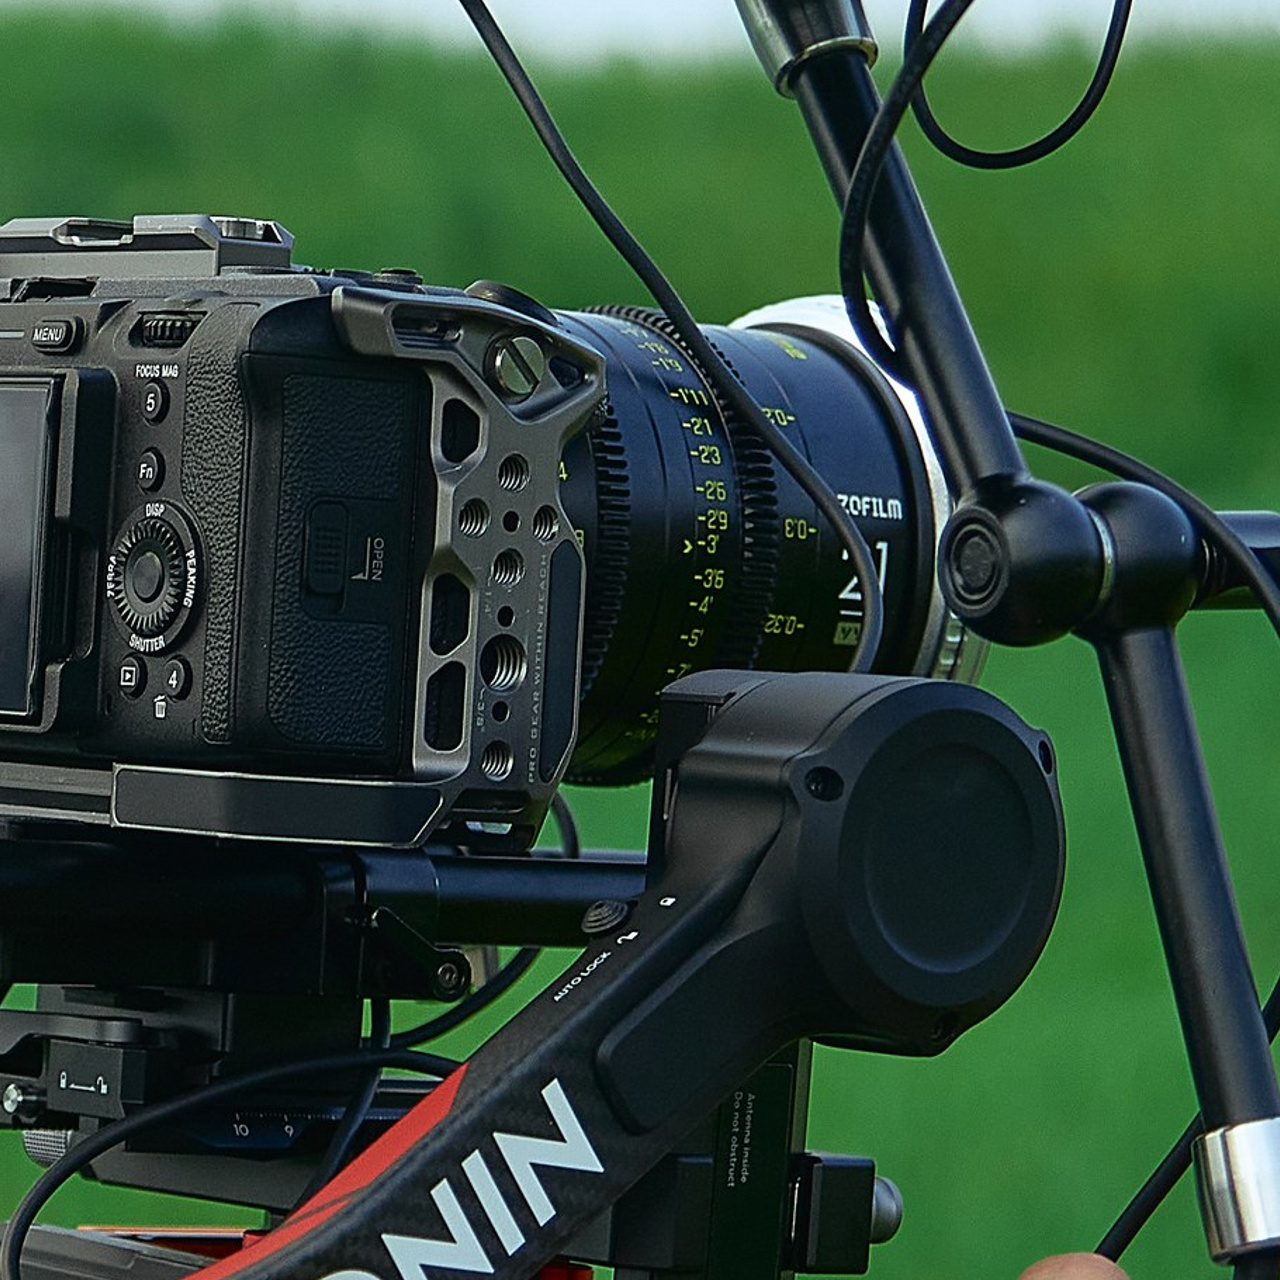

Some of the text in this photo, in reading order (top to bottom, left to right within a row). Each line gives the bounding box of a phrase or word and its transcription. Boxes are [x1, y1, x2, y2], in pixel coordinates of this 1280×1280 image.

[33, 327, 63, 342] MENU
[135, 364, 179, 378] FOCUS MAG
[146, 393, 156, 412] 5
[138, 463, 153, 479] Fn
[145, 503, 165, 517] DISP
[837, 493, 903, 520] ZOFILM
[371, 537, 385, 581] OPEN
[183, 549, 197, 608] PEAKING
[128, 632, 166, 652] SHUTTER
[528, 554, 547, 783] PRO GEAR WITHIN REACH
[168, 669, 178, 689] 4
[553, 951, 612, 1002] AUTO LOCK
[233, 1123, 294, 1137] 10 9
[727, 1091, 743, 1187] Do not obstruct
[740, 1093, 756, 1183] Antenna inside
